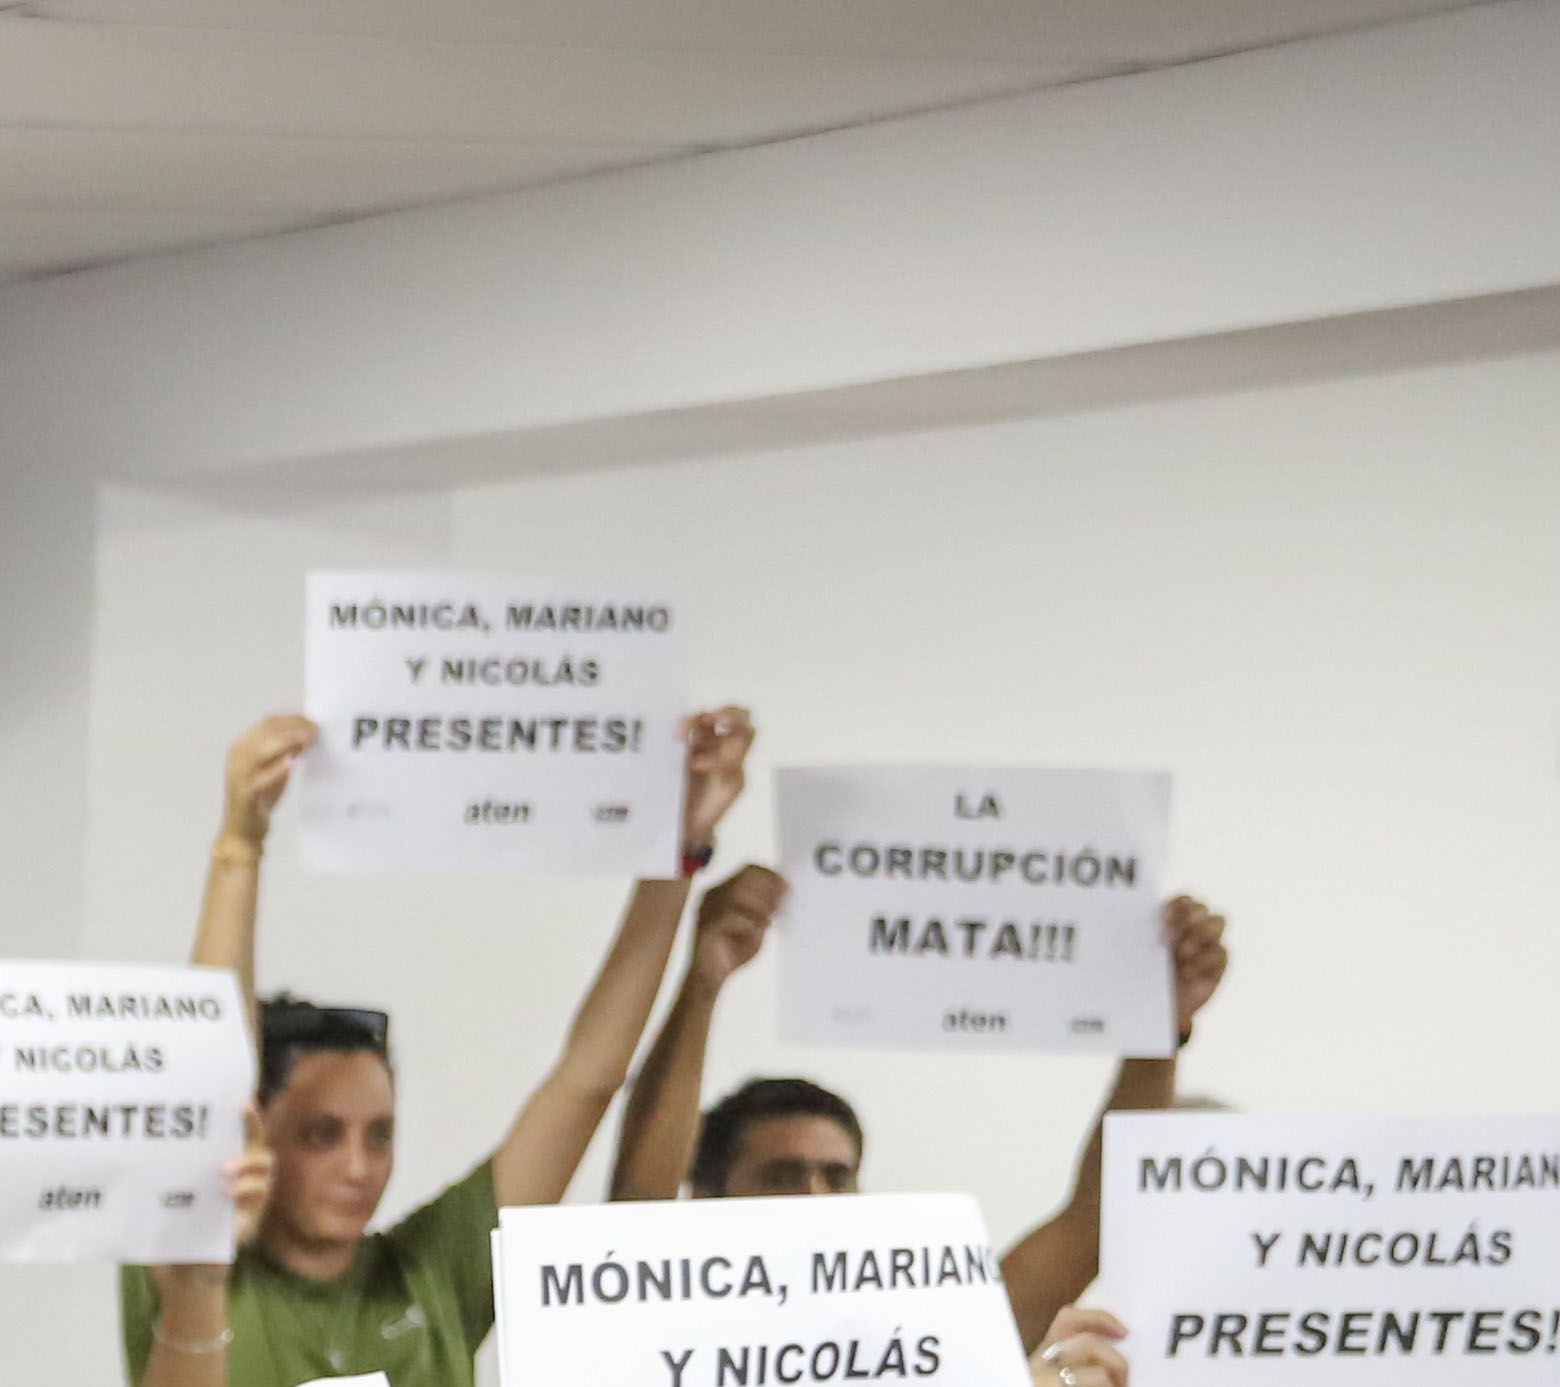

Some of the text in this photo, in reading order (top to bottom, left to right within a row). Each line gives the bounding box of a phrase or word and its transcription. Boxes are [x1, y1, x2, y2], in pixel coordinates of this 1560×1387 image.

[330, 598, 670, 633] MÓNICA, MARIANO
[406, 655, 600, 686] Y NICOLÁS
[352, 716, 643, 753] PRESENTES!
[464, 799, 531, 825] aten
[955, 794, 1001, 819] LA
[812, 840, 1138, 888] CORRUPCIÓN
[869, 916, 1075, 961] MATA!!!
[68, 994, 221, 1020] MARIANO
[942, 1008, 1008, 1032] aten
[15, 1043, 164, 1073] NICOLÁS
[1139, 1149, 1560, 1198] MÓNICA, MARIAN
[39, 1186, 102, 1211] aten
[1252, 1220, 1513, 1268] Y NICOLÁS
[541, 1251, 787, 1307] MÓNICA,
[1166, 1310, 1560, 1357] PRESENTES!
[717, 1328, 940, 1387] NICOLÁS
